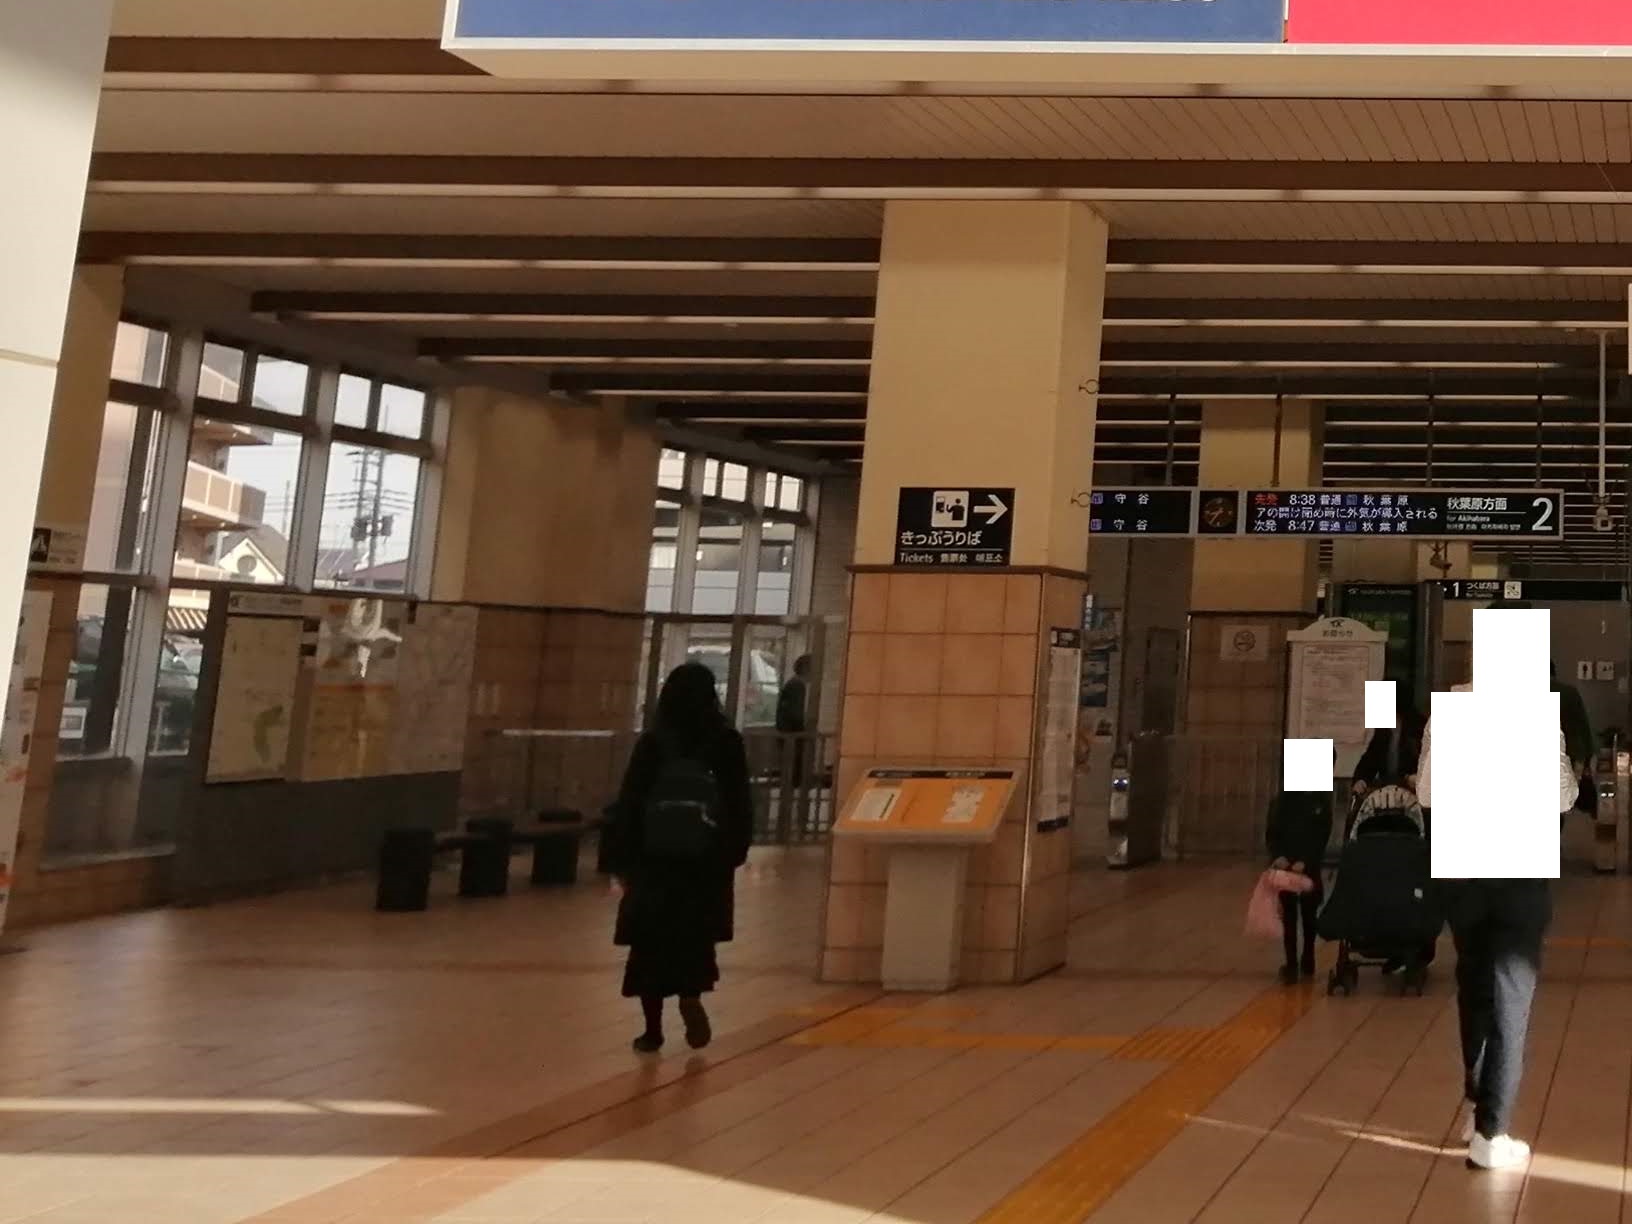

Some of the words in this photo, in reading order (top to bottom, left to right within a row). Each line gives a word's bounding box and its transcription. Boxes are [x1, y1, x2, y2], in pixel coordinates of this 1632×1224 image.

[1288, 493, 1317, 506] 8:38
[1446, 497, 1508, 511] 秋葉原方面
[1531, 496, 1554, 532] 2
[1287, 519, 1316, 532] 8:47
[900, 529, 983, 546] きっぷうりば
[899, 552, 935, 564] Tickets
